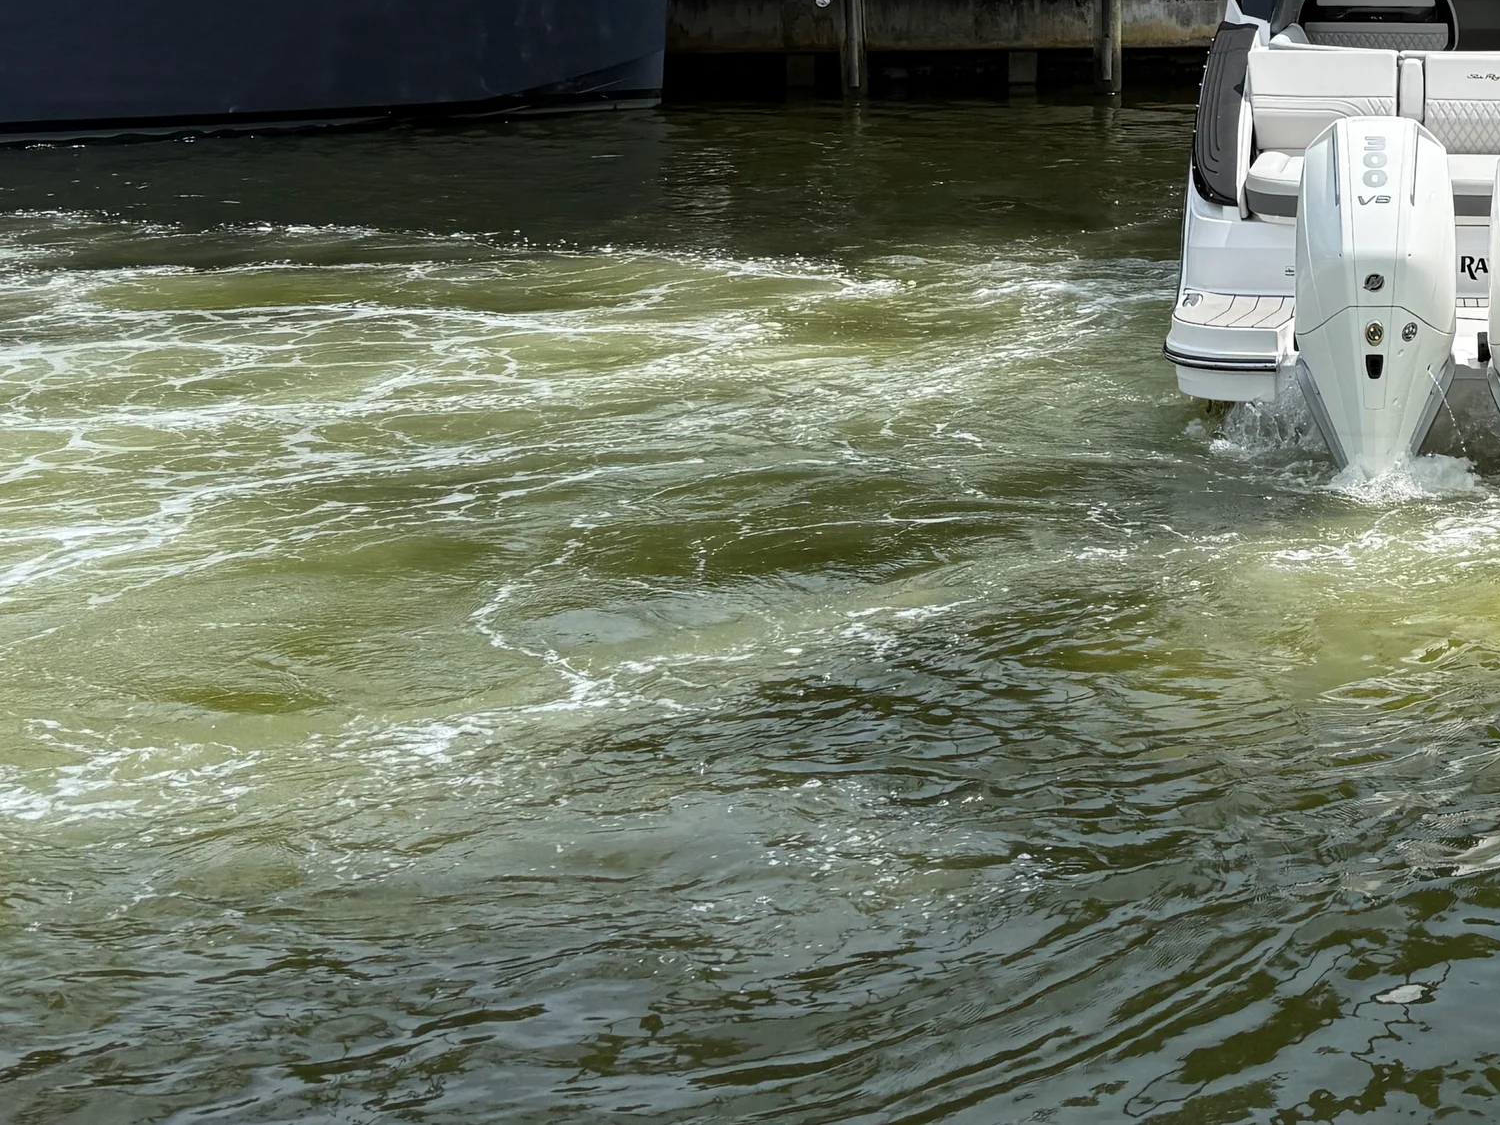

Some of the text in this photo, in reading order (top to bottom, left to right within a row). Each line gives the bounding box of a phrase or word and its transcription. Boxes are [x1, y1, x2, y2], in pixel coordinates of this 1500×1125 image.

[1362, 136, 1388, 188] 300
[1357, 195, 1392, 206] V6
[1460, 255, 1490, 281] RA
